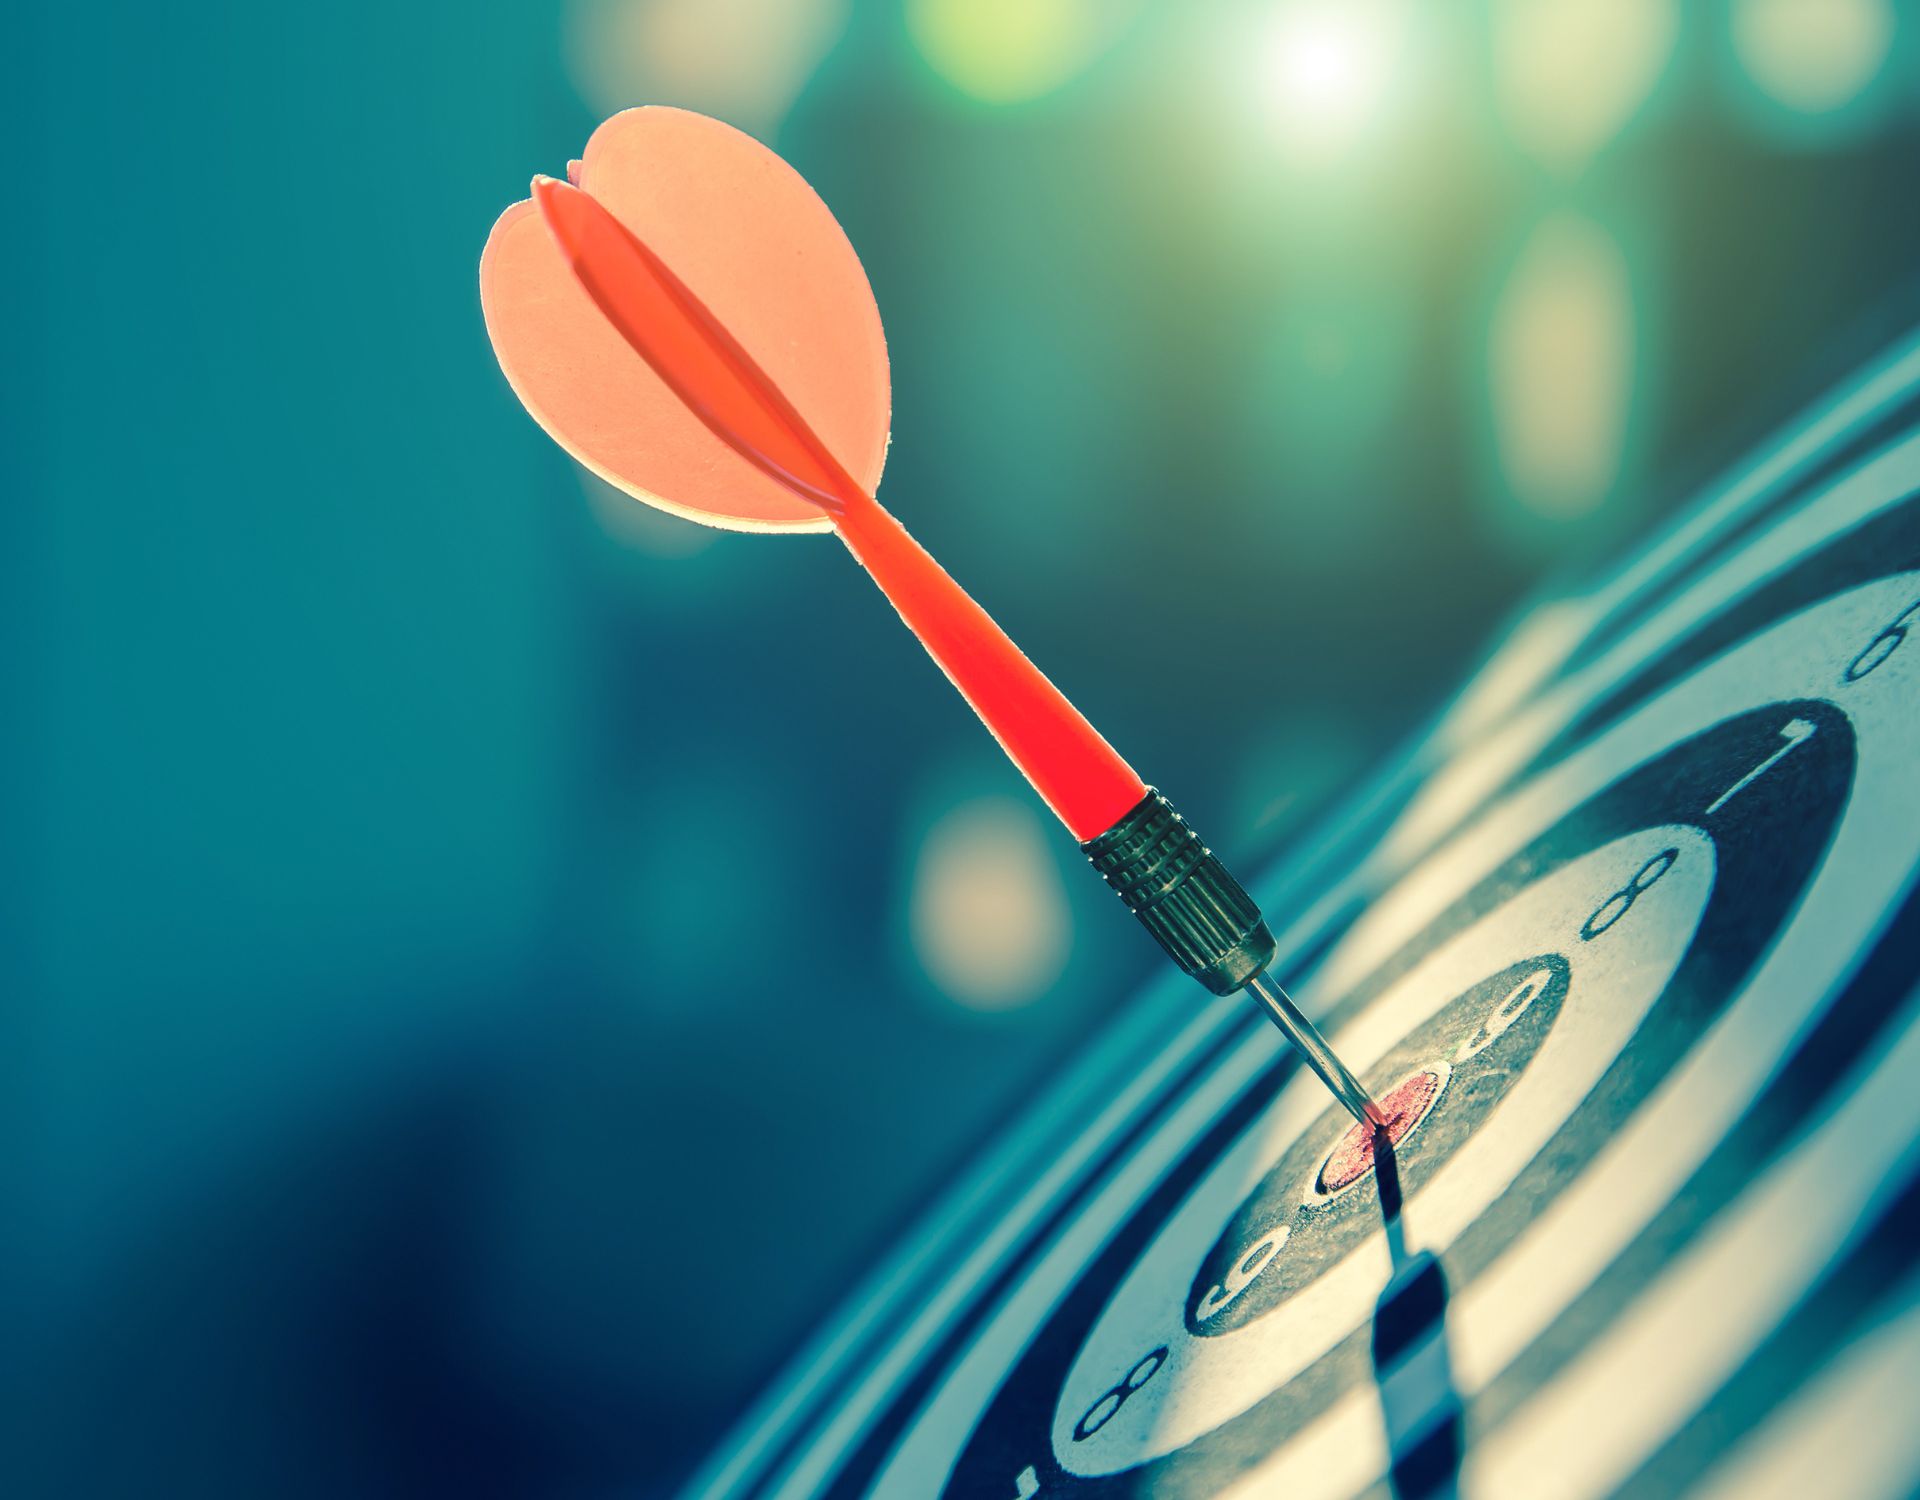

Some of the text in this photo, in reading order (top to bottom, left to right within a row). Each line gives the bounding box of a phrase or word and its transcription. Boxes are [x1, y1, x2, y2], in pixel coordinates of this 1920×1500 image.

[1705, 718, 1817, 815] 7
[1579, 848, 1679, 942] 8
[1454, 968, 1553, 1063] 9
[1196, 1226, 1291, 1322] 9
[1072, 1346, 1168, 1442] 8
